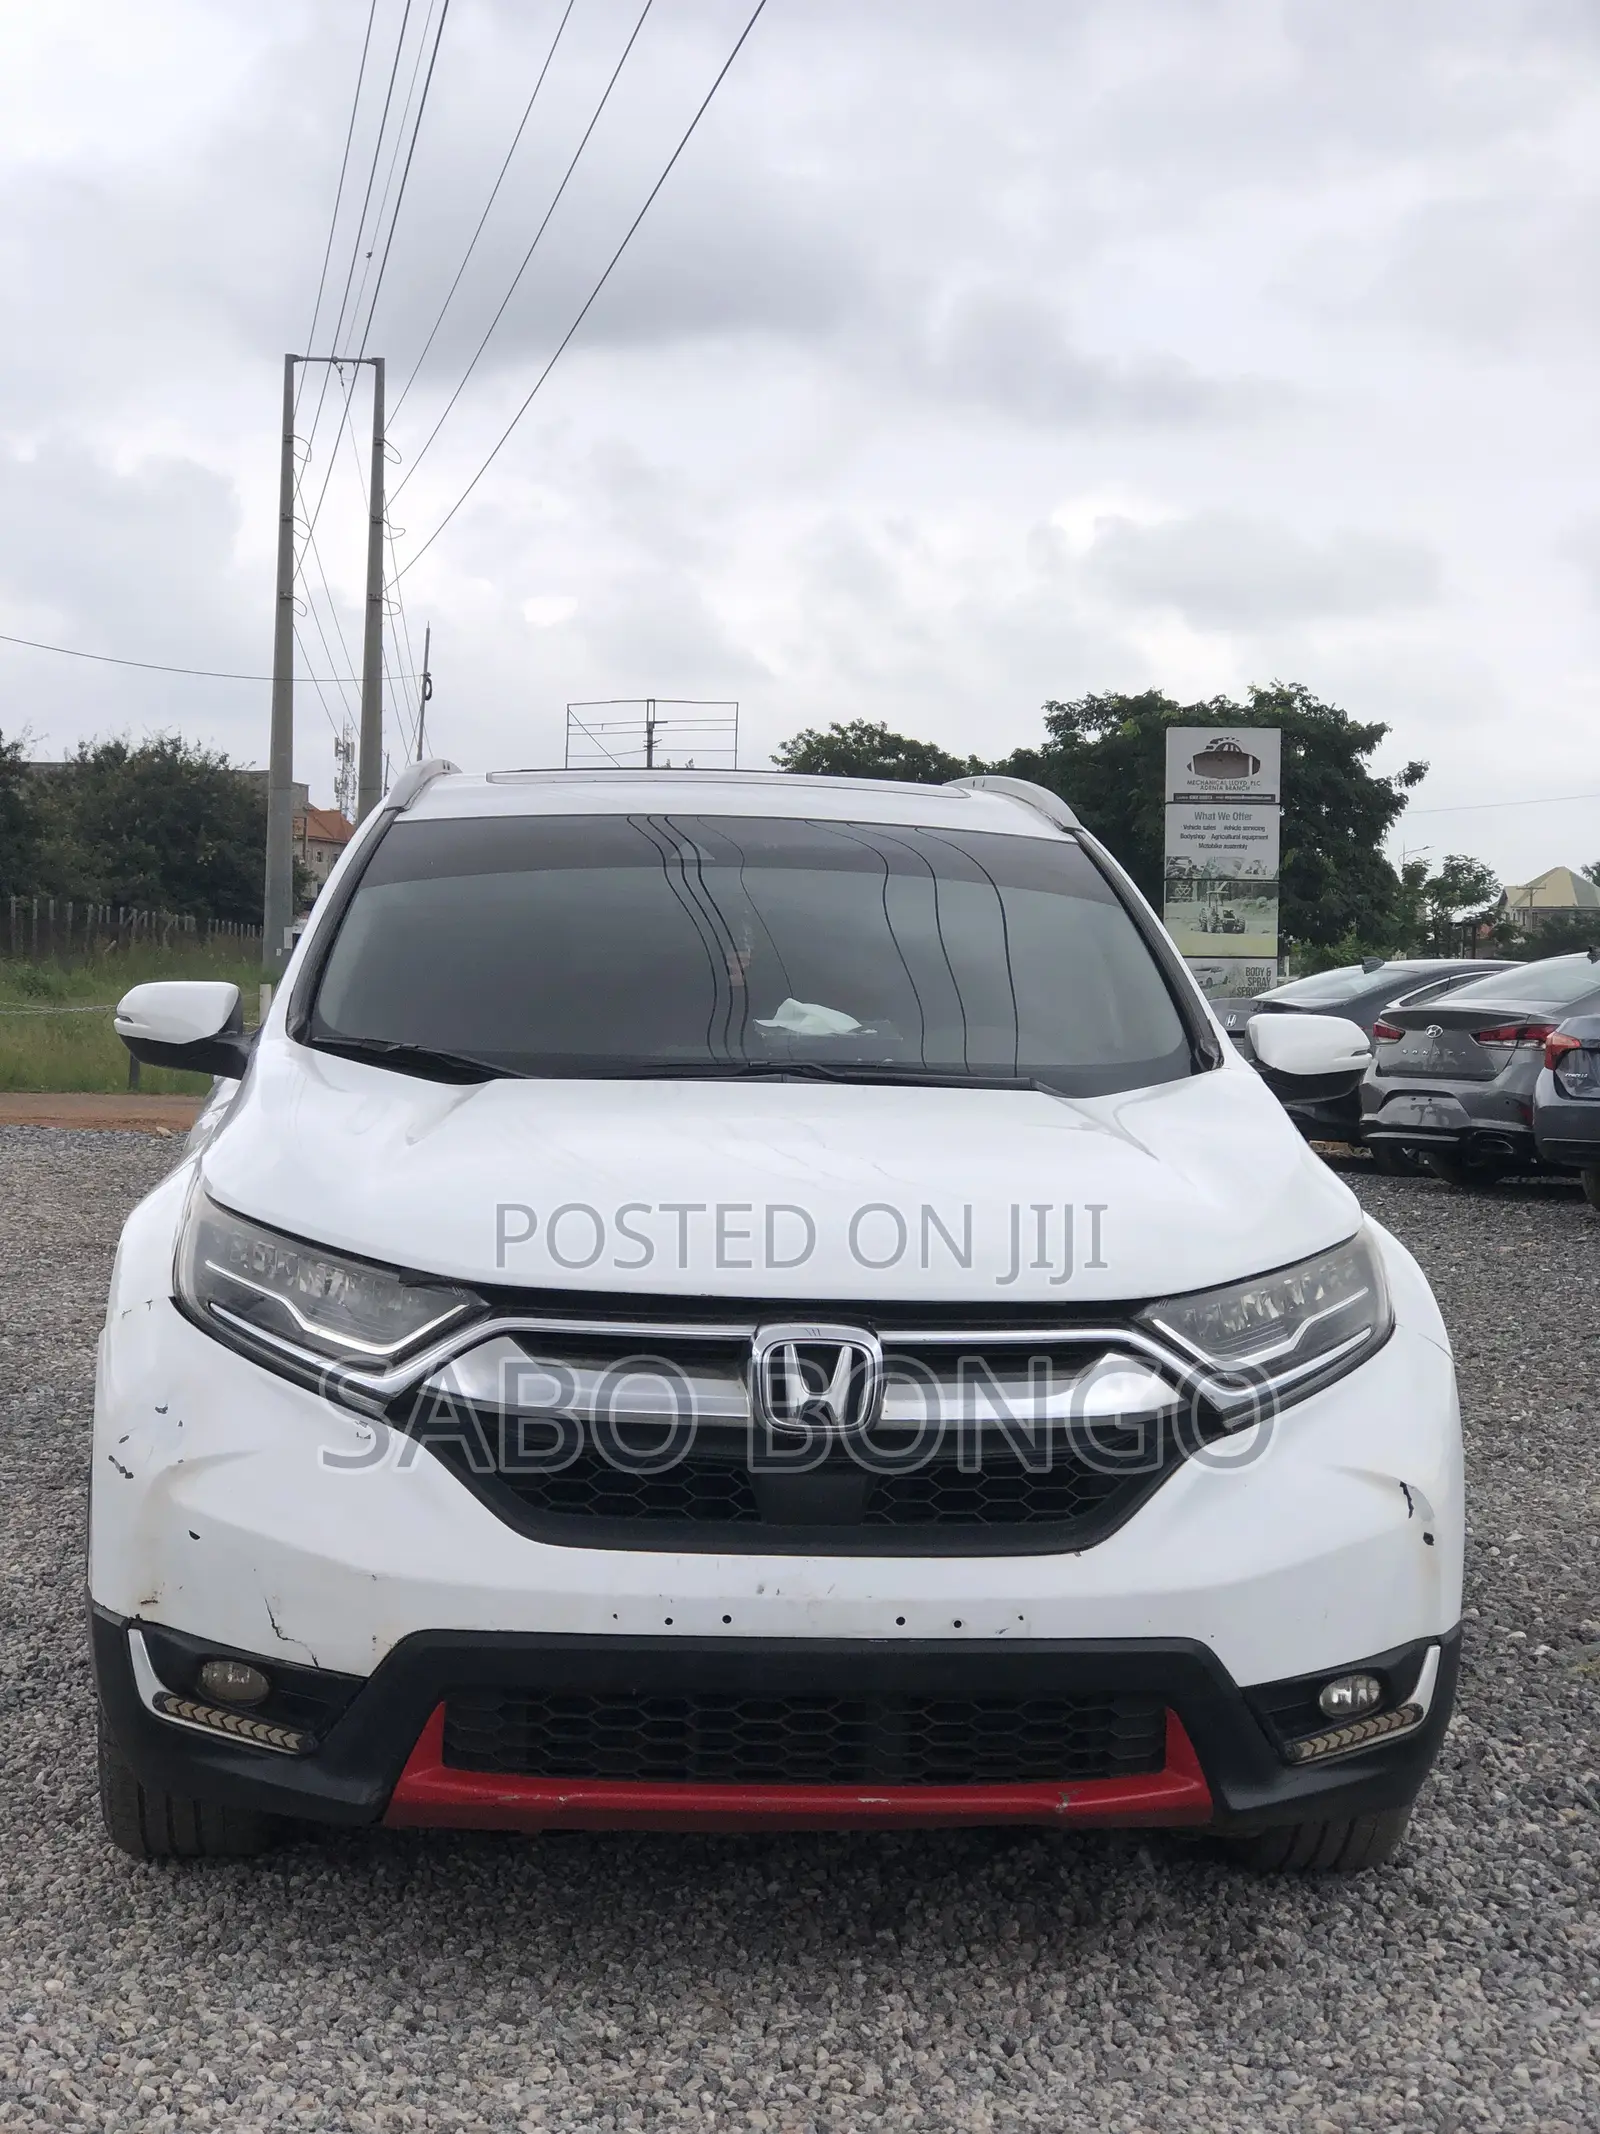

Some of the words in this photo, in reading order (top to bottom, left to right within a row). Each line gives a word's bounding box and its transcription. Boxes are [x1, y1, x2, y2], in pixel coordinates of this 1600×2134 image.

[1194, 811, 1216, 820] What
[1218, 811, 1231, 820] We
[1232, 811, 1253, 820] Offer
[1246, 967, 1264, 976] BODY
[1248, 977, 1271, 986] SPRAY
